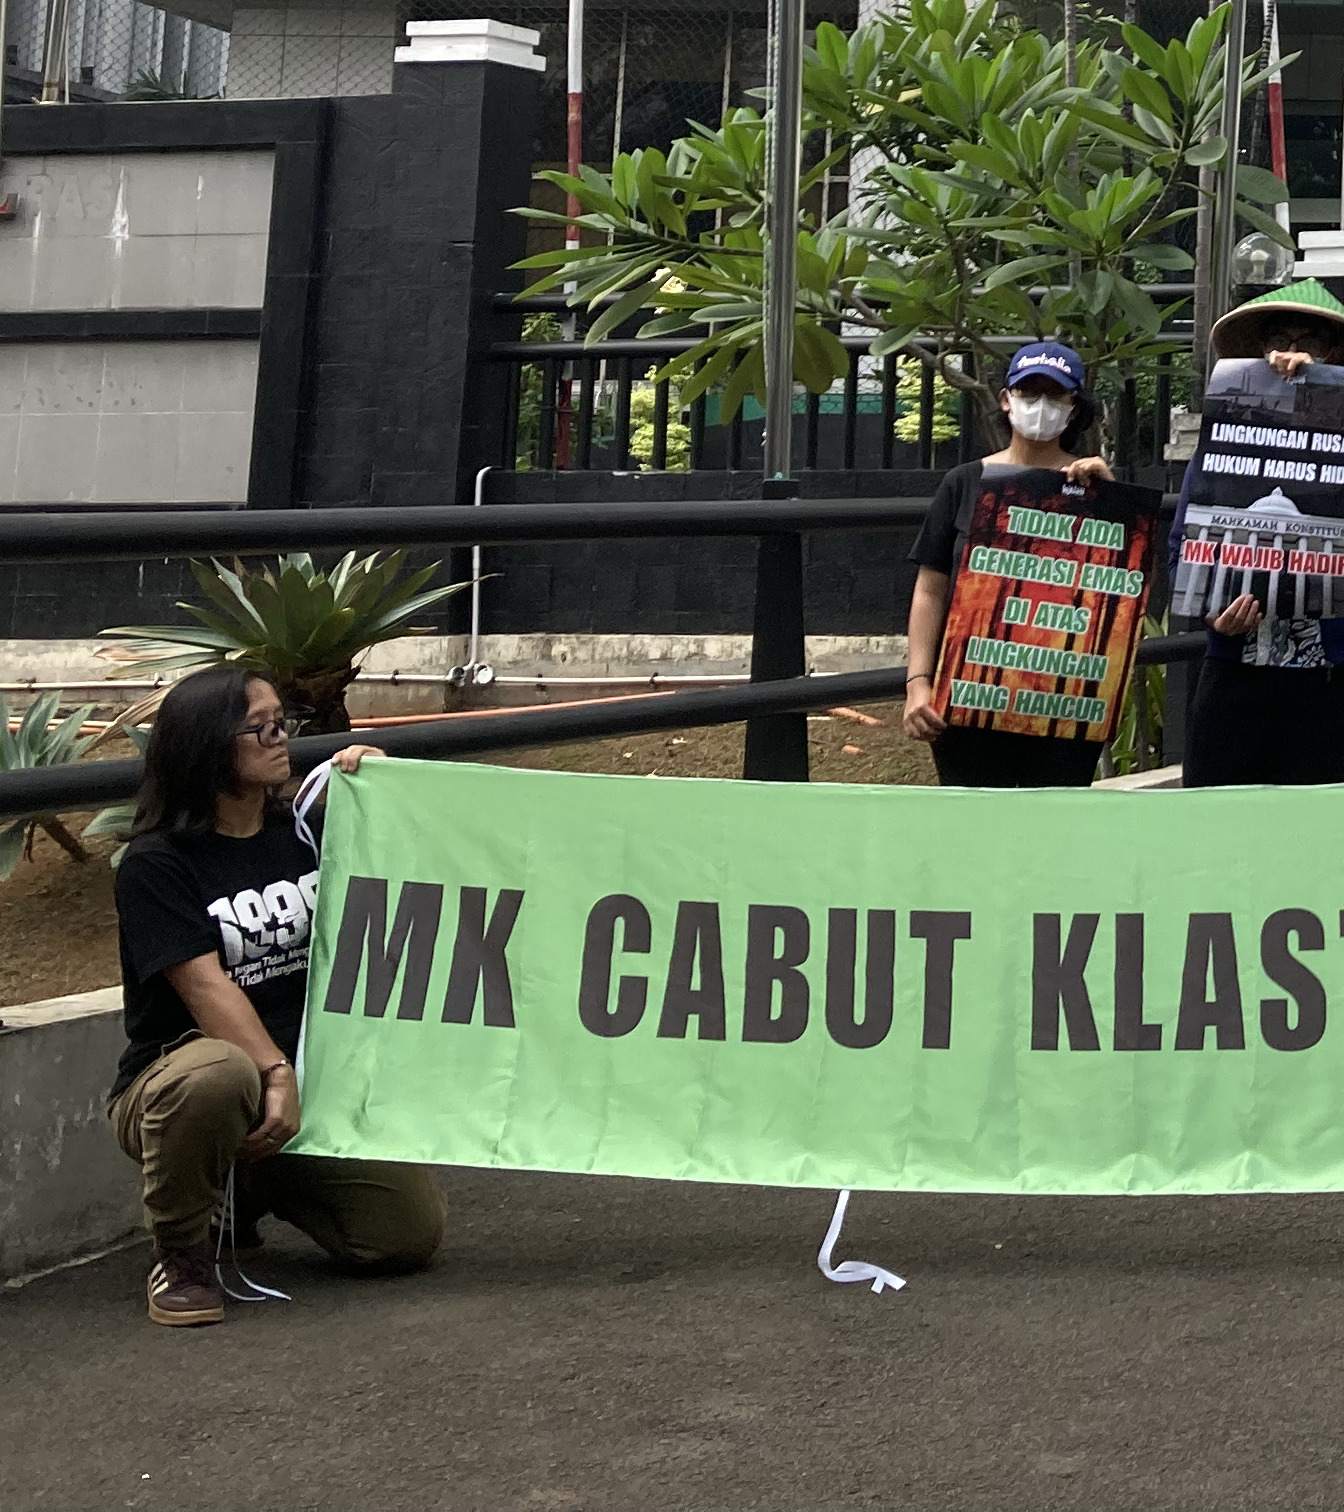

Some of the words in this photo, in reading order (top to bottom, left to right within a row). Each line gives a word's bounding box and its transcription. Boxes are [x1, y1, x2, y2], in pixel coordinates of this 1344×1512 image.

[1211, 422, 1309, 451] LINGKUNGAN
[1202, 453, 1261, 477] HUKUM
[1263, 458, 1317, 482] HARUS
[1007, 505, 1077, 542] TIDAK
[1075, 517, 1125, 550] ADA
[1211, 515, 1279, 531] MAHKAMAH
[969, 545, 1078, 588] GENERASI
[1079, 563, 1144, 597] EMAS
[1183, 539, 1215, 566] MK
[1219, 543, 1284, 572] WAJIB
[1002, 596, 1032, 626] DI
[1032, 601, 1092, 634] ATAS
[965, 636, 1109, 681] LINGKUNGAN
[950, 678, 1011, 712] YANG
[1014, 689, 1107, 723] HANCUR
[323, 874, 525, 1030] MK
[577, 893, 972, 1051] CABUT
